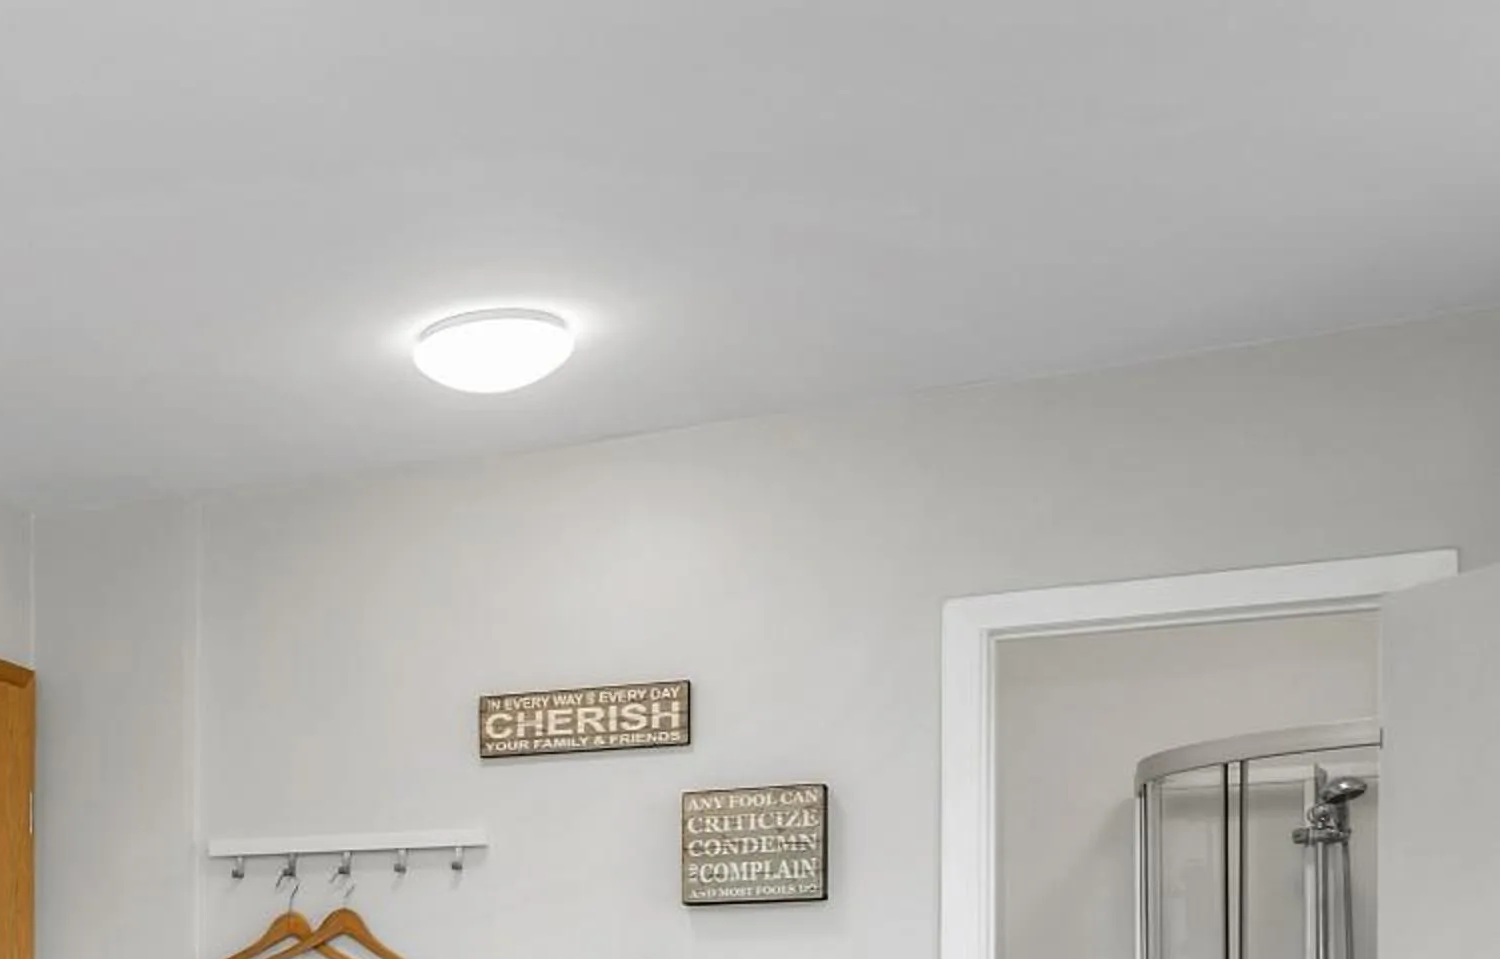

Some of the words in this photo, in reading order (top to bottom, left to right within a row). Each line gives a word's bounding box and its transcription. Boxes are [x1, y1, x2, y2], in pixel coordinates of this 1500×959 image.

[486, 700, 500, 711] IN
[504, 696, 549, 711] EVERY
[552, 693, 584, 706] WAY
[598, 689, 647, 704] EVERY
[650, 686, 681, 700] DAY
[485, 701, 681, 739] CHERISH
[486, 739, 529, 752] YOUR
[533, 735, 589, 749] FAMILY
[593, 734, 605, 745] &
[609, 731, 681, 745] FRIENDS
[688, 796, 725, 811] ANY
[729, 793, 777, 808] FOOL
[780, 789, 818, 804] CAN
[687, 808, 820, 834] CRITICIZE
[688, 833, 818, 857] CONDEMN
[700, 857, 817, 883] COMPLAIN
